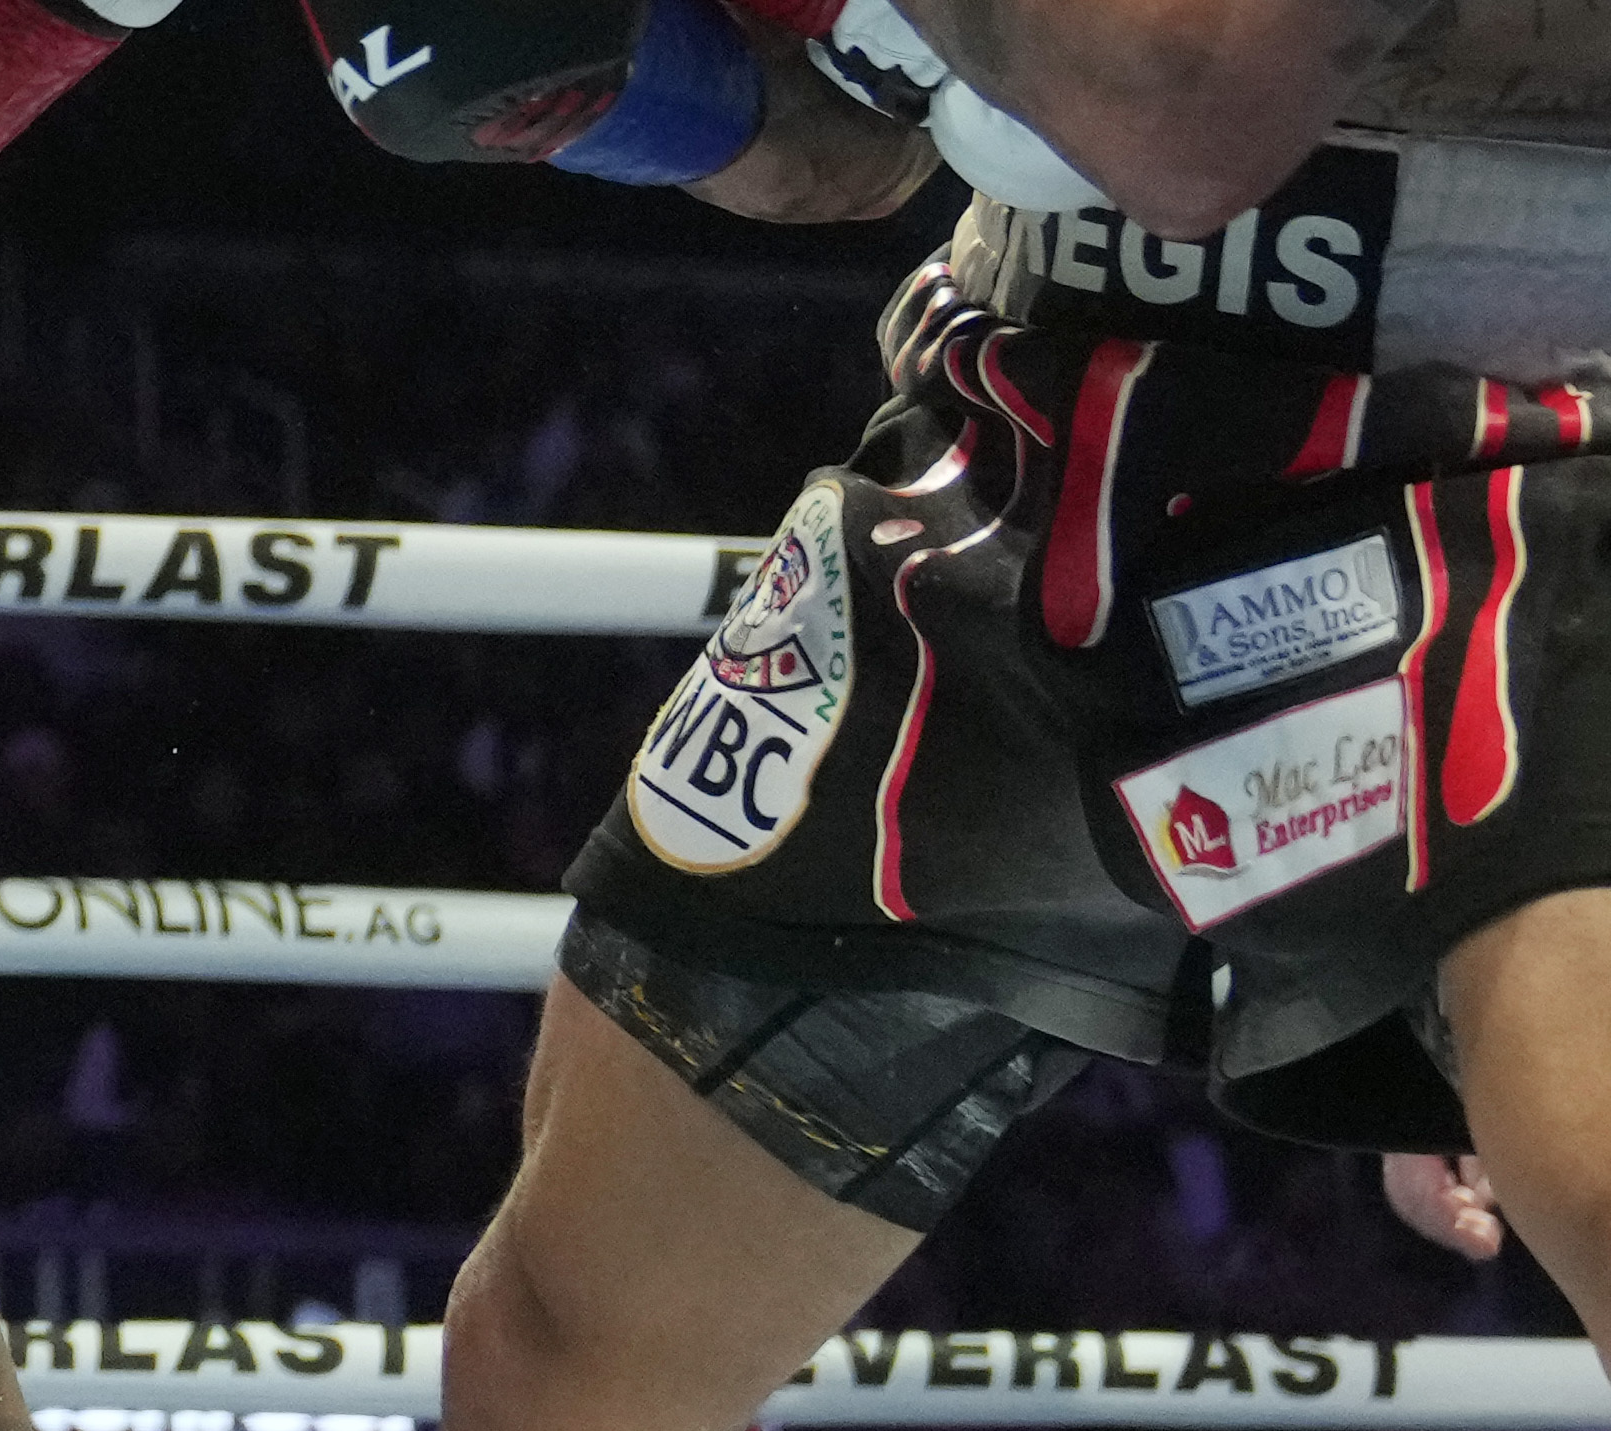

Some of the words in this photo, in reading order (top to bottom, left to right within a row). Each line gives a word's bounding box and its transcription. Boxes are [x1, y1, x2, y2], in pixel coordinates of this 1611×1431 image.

[801, 499, 848, 723] CHAMPION
[1210, 568, 1348, 636] AMMO
[647, 676, 793, 832] WBC
[784, 1330, 1417, 1400] VERLAST
